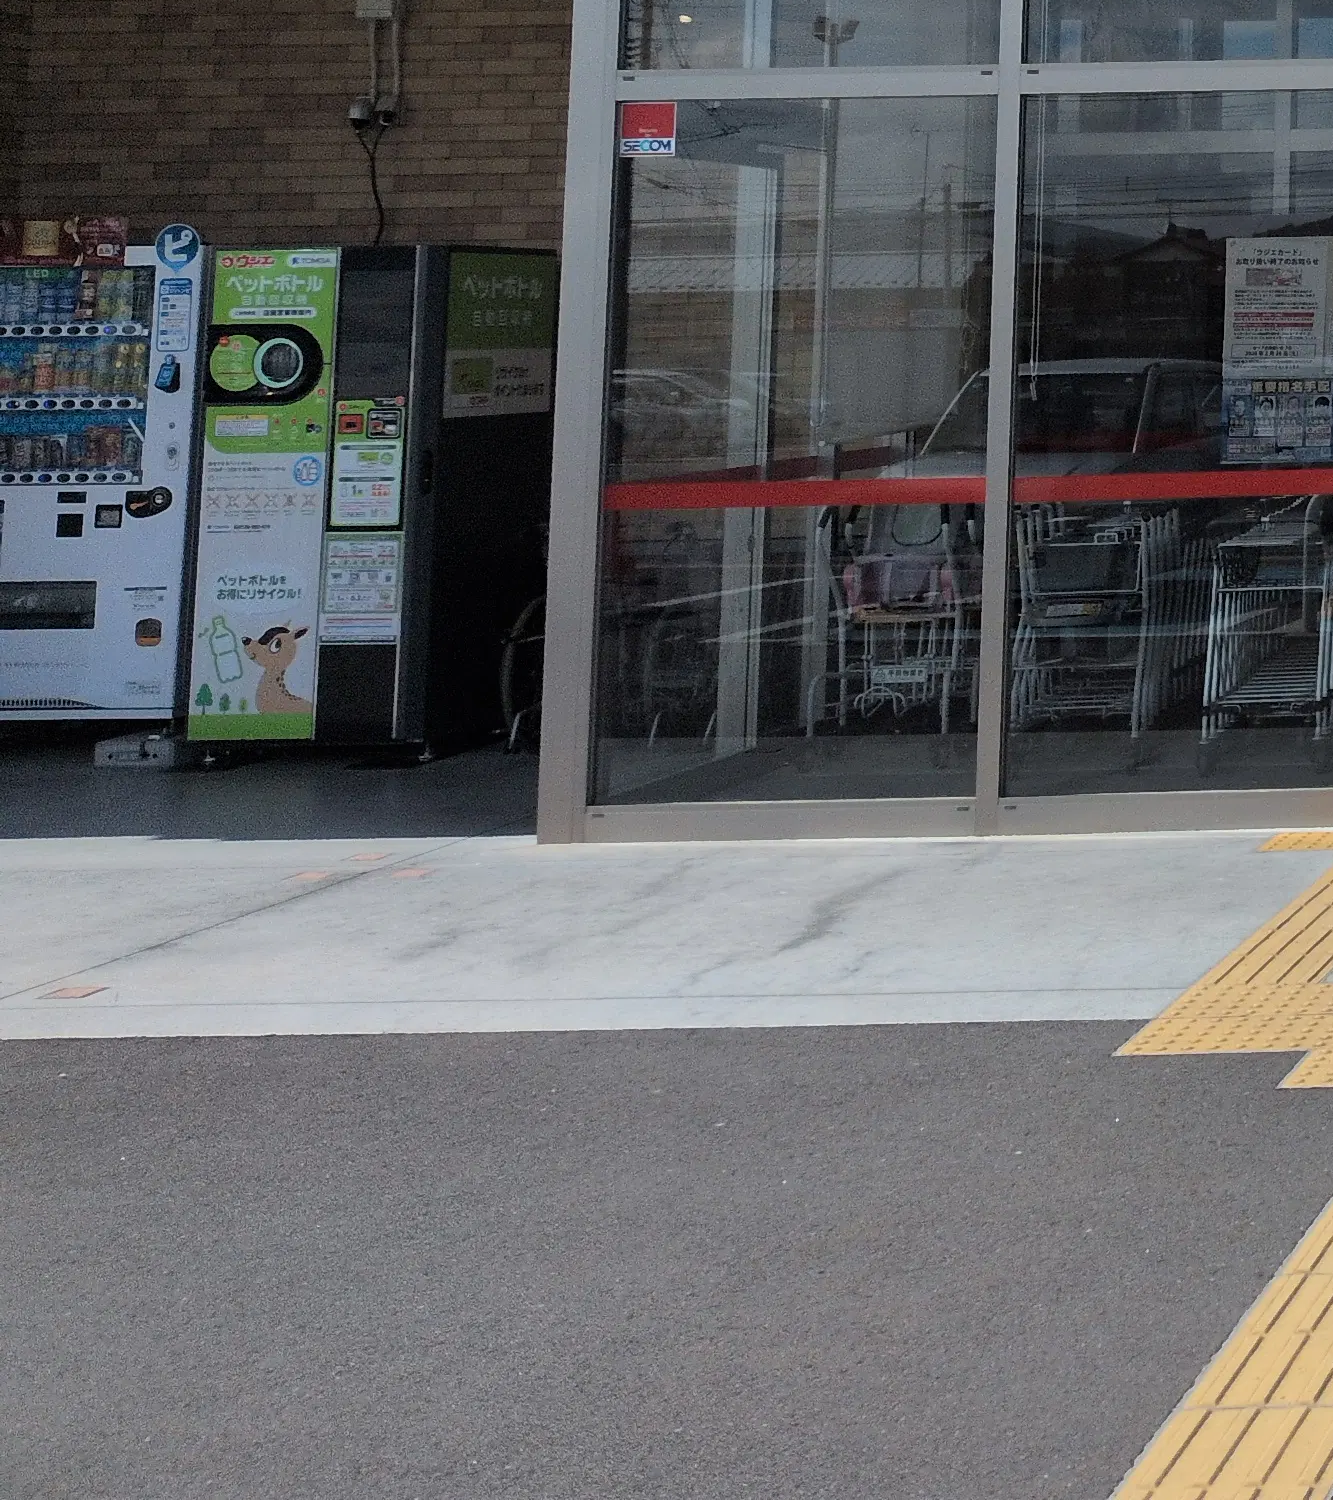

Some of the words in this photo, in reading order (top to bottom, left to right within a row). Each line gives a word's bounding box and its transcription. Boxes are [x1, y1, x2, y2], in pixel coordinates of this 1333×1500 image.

[623, 140, 671, 152] SECOM
[226, 274, 324, 292] ペットボトル
[217, 575, 287, 586] ペットボトルを
